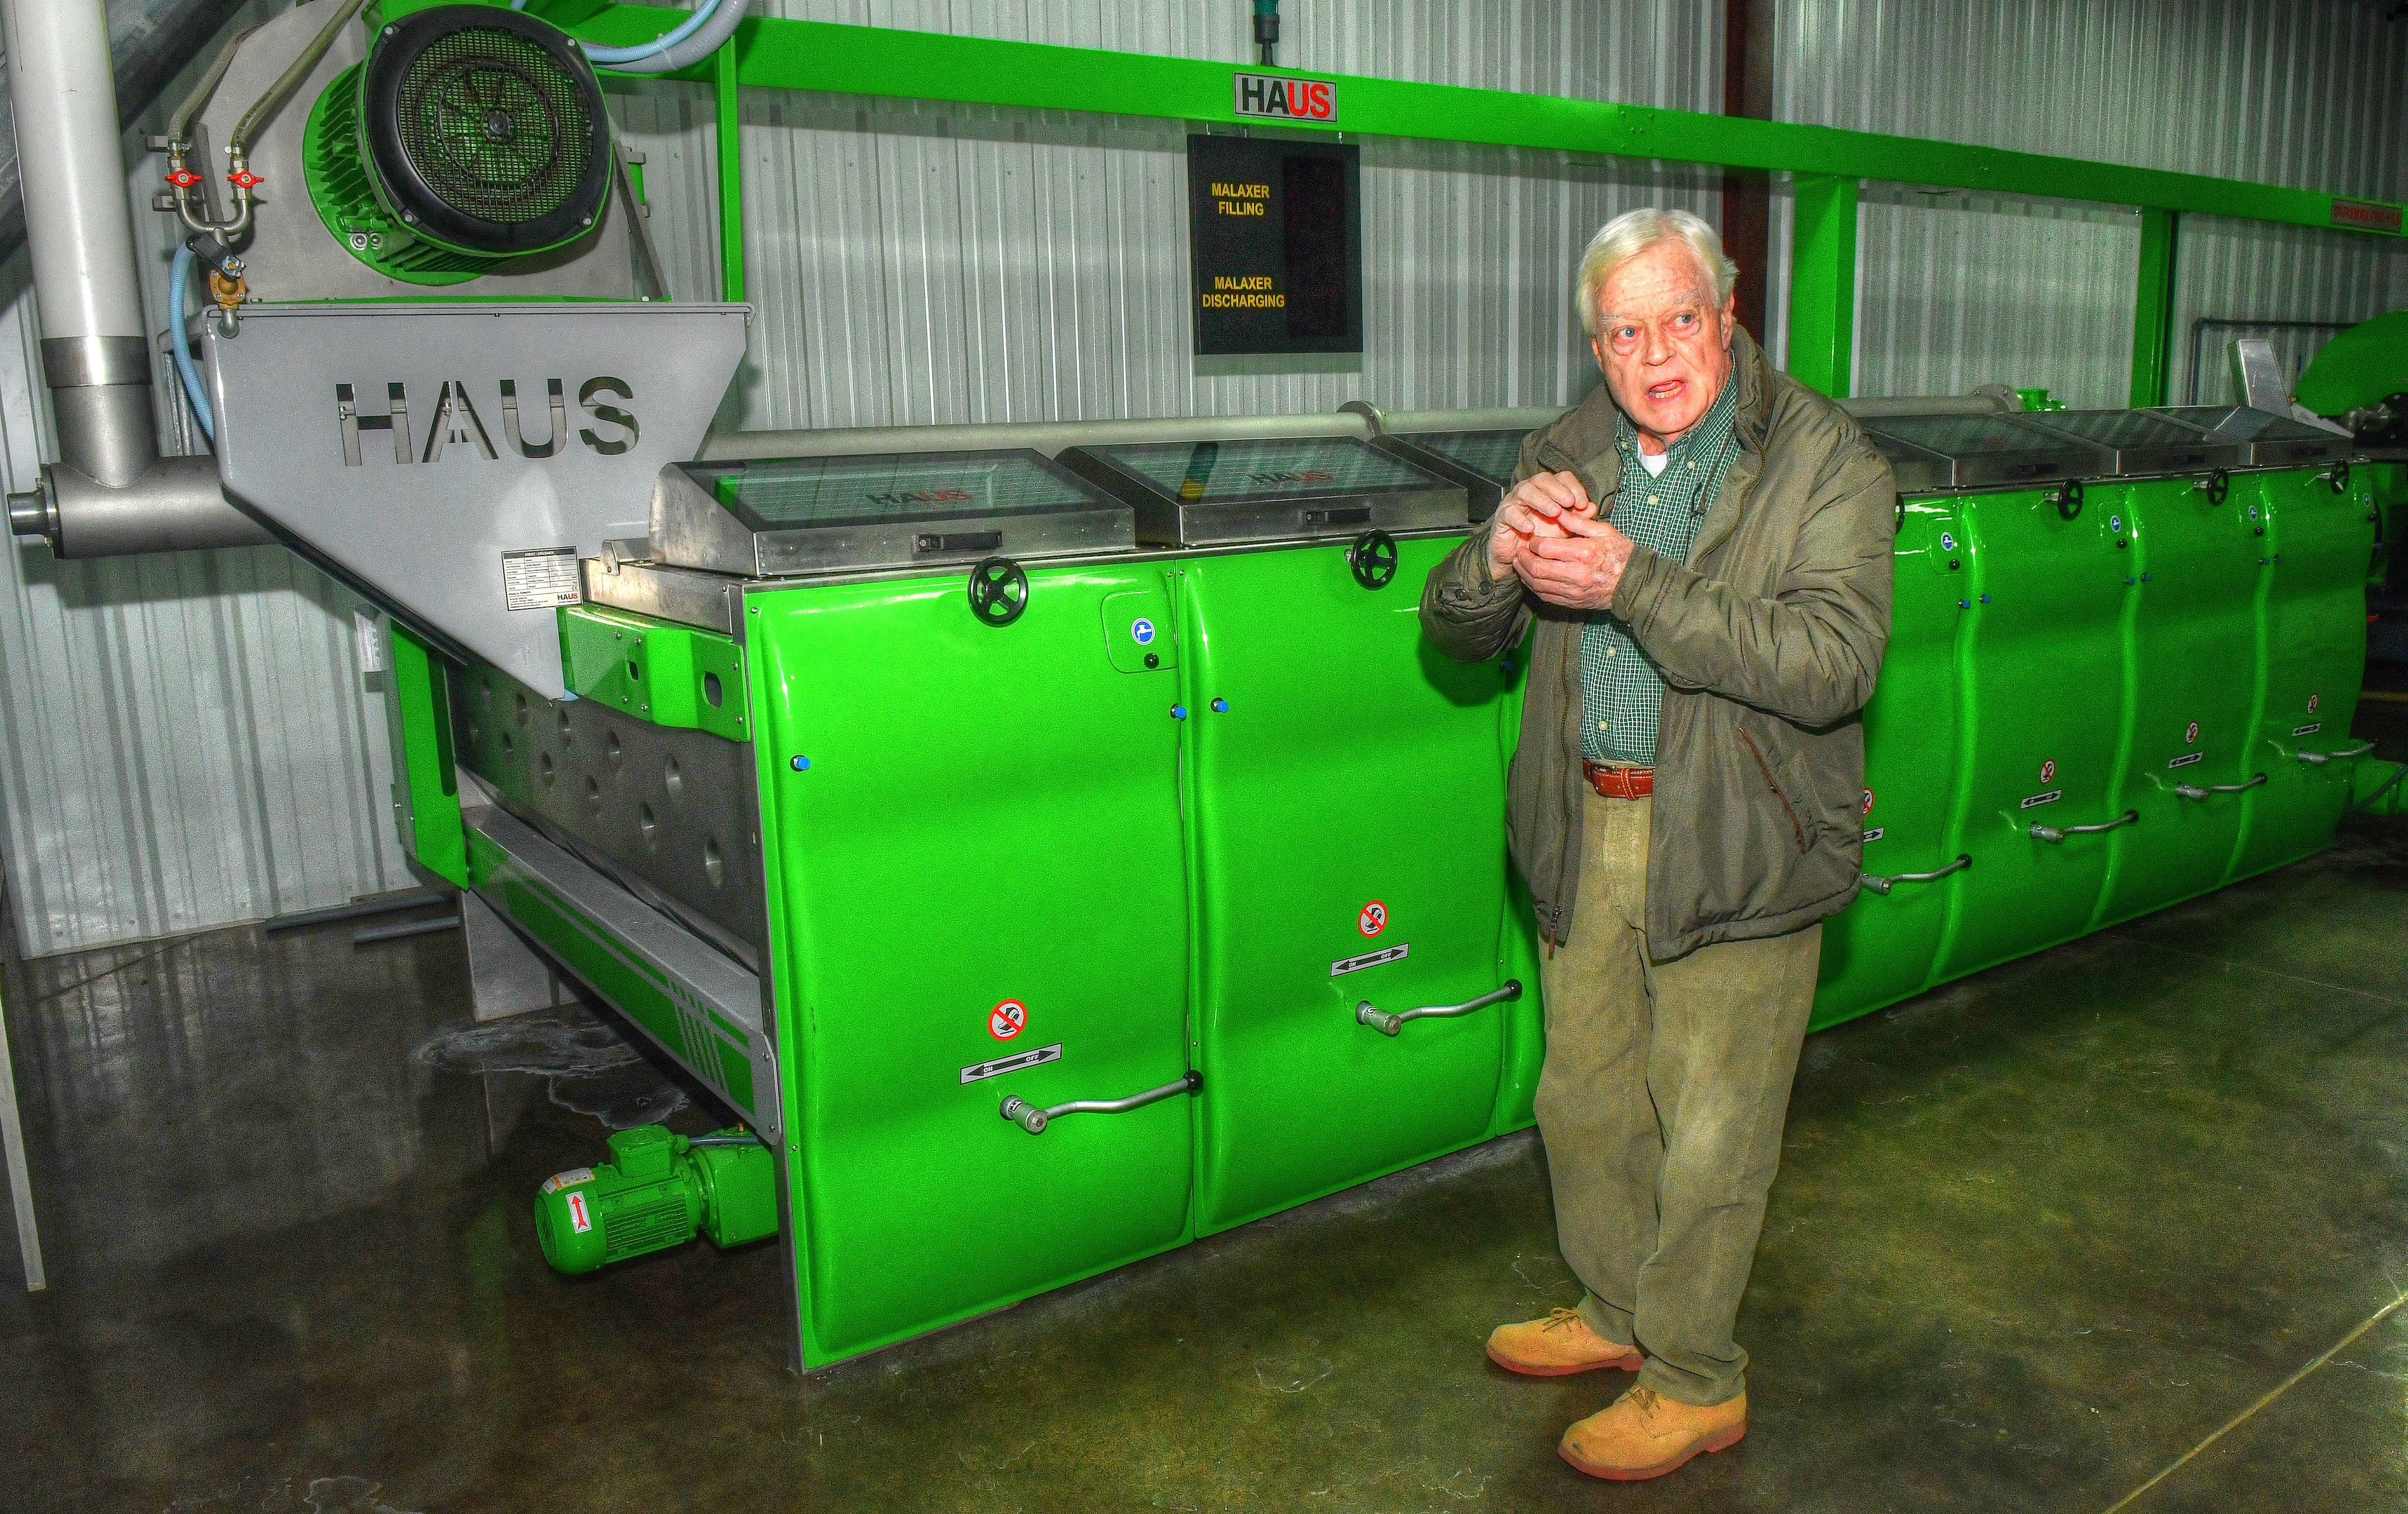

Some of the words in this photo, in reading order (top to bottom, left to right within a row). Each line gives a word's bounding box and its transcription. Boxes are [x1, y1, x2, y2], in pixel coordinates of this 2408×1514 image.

[1242, 77, 1330, 118] HAUS
[1212, 182, 1270, 198] MALAXER
[1218, 201, 1264, 216] FILLING
[1215, 276, 1272, 290] MALAXER
[1202, 294, 1285, 308] DISCHARGING
[335, 376, 641, 467] HAUS
